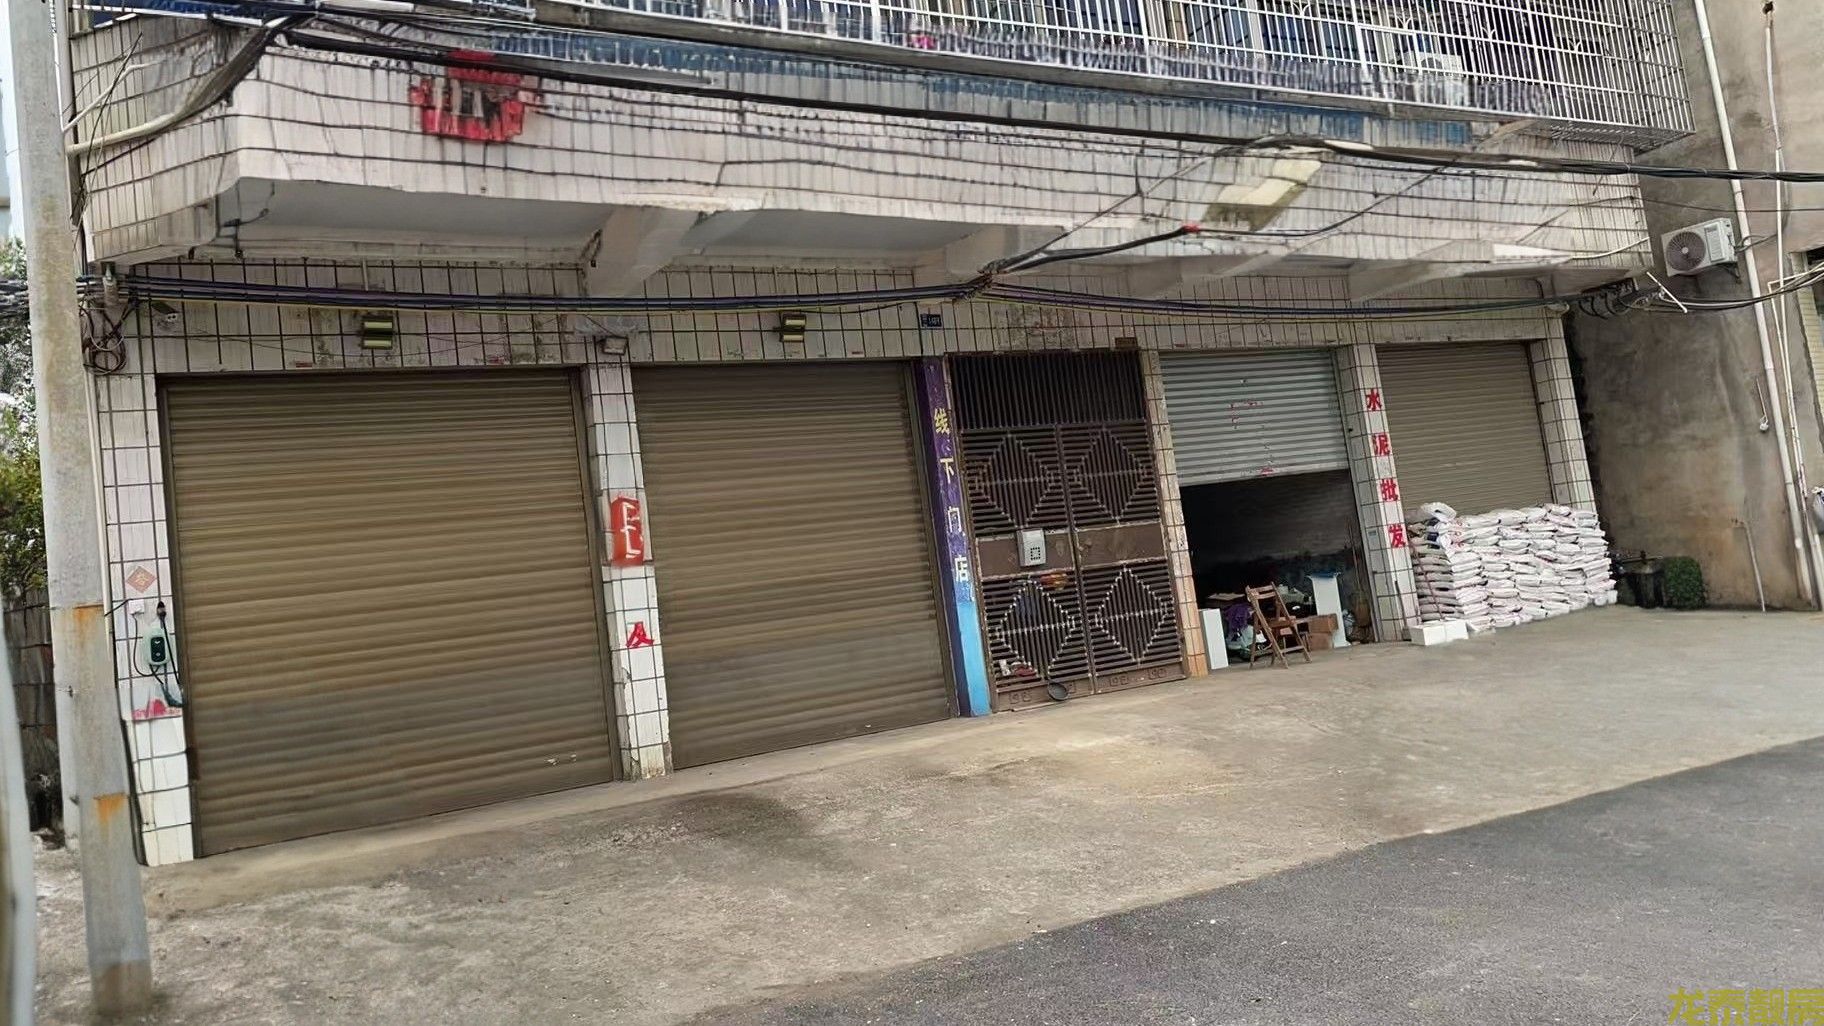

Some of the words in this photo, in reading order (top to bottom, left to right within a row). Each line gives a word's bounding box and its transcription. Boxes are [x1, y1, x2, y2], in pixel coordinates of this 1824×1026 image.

[934, 408, 969, 582] 线下门店
[1366, 388, 1405, 548] 水泥批发
